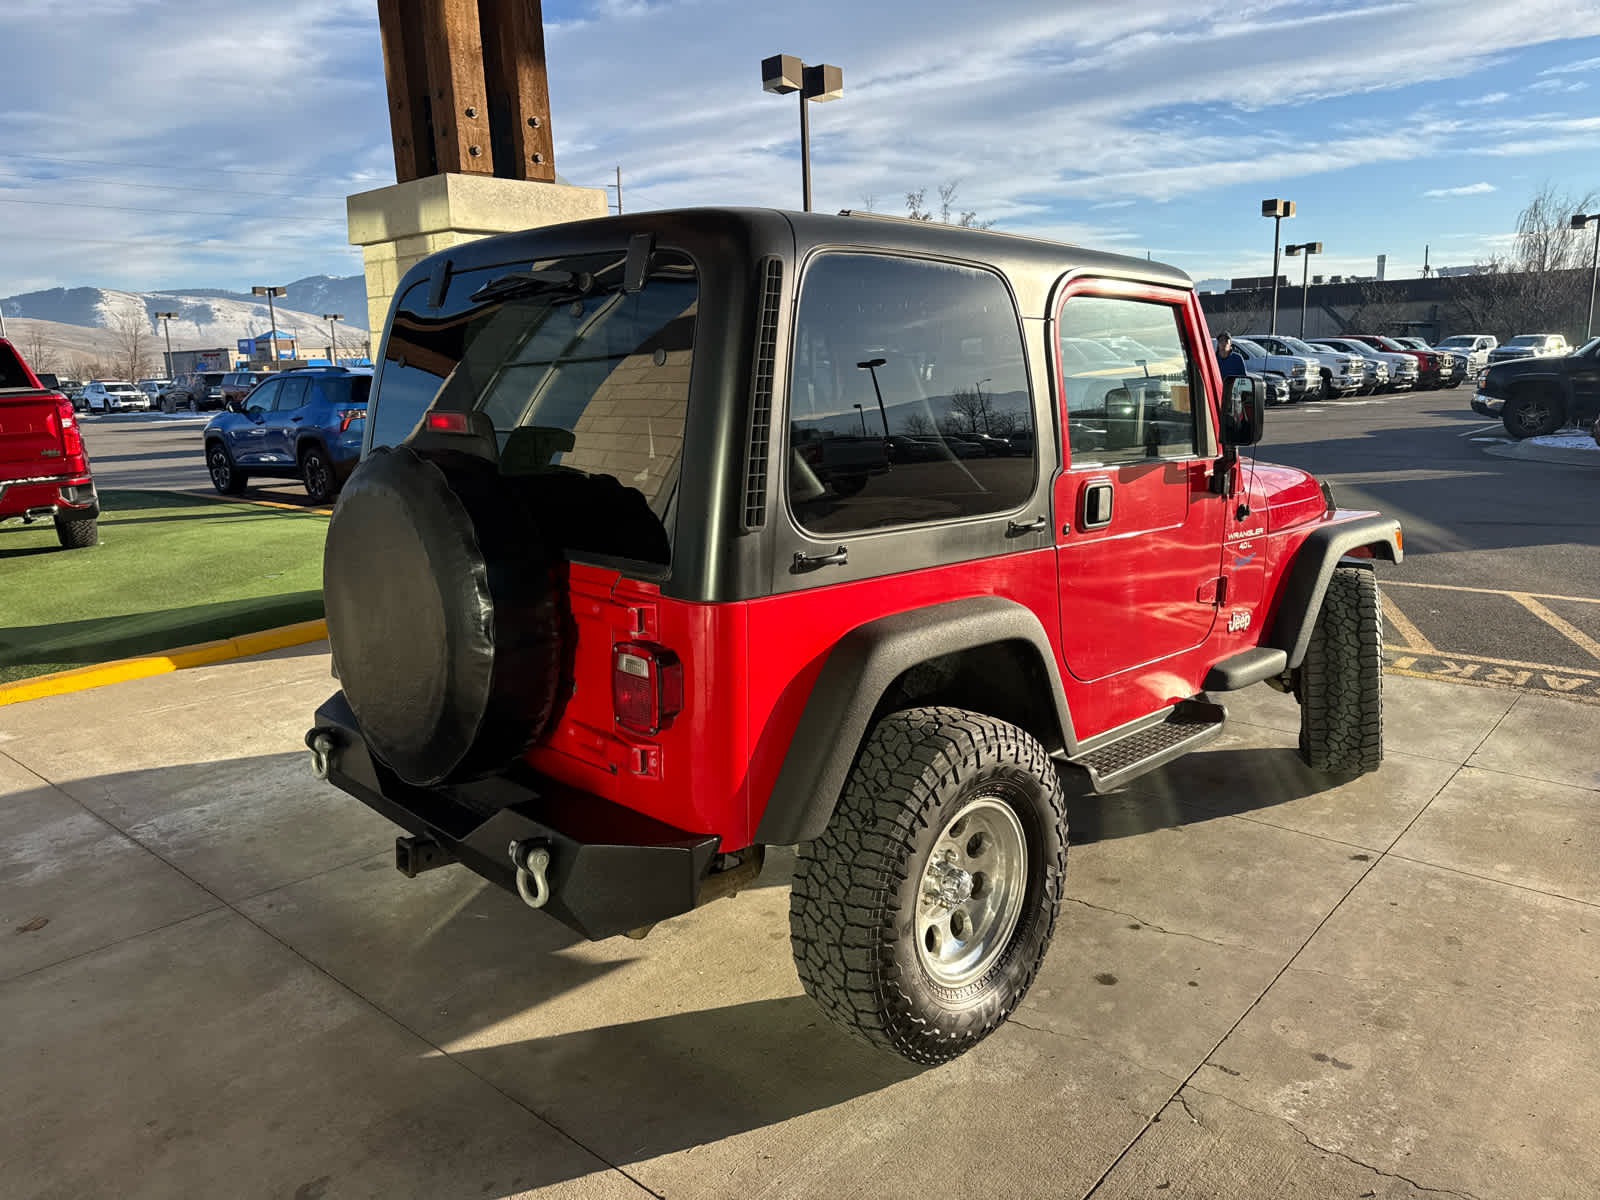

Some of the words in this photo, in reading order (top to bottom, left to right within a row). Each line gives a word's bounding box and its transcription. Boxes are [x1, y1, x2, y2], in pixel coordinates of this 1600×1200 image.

[1228, 527, 1264, 540] WRANGLER
[1228, 611, 1251, 633] Jeep
[1392, 655, 1600, 696] ARKI
